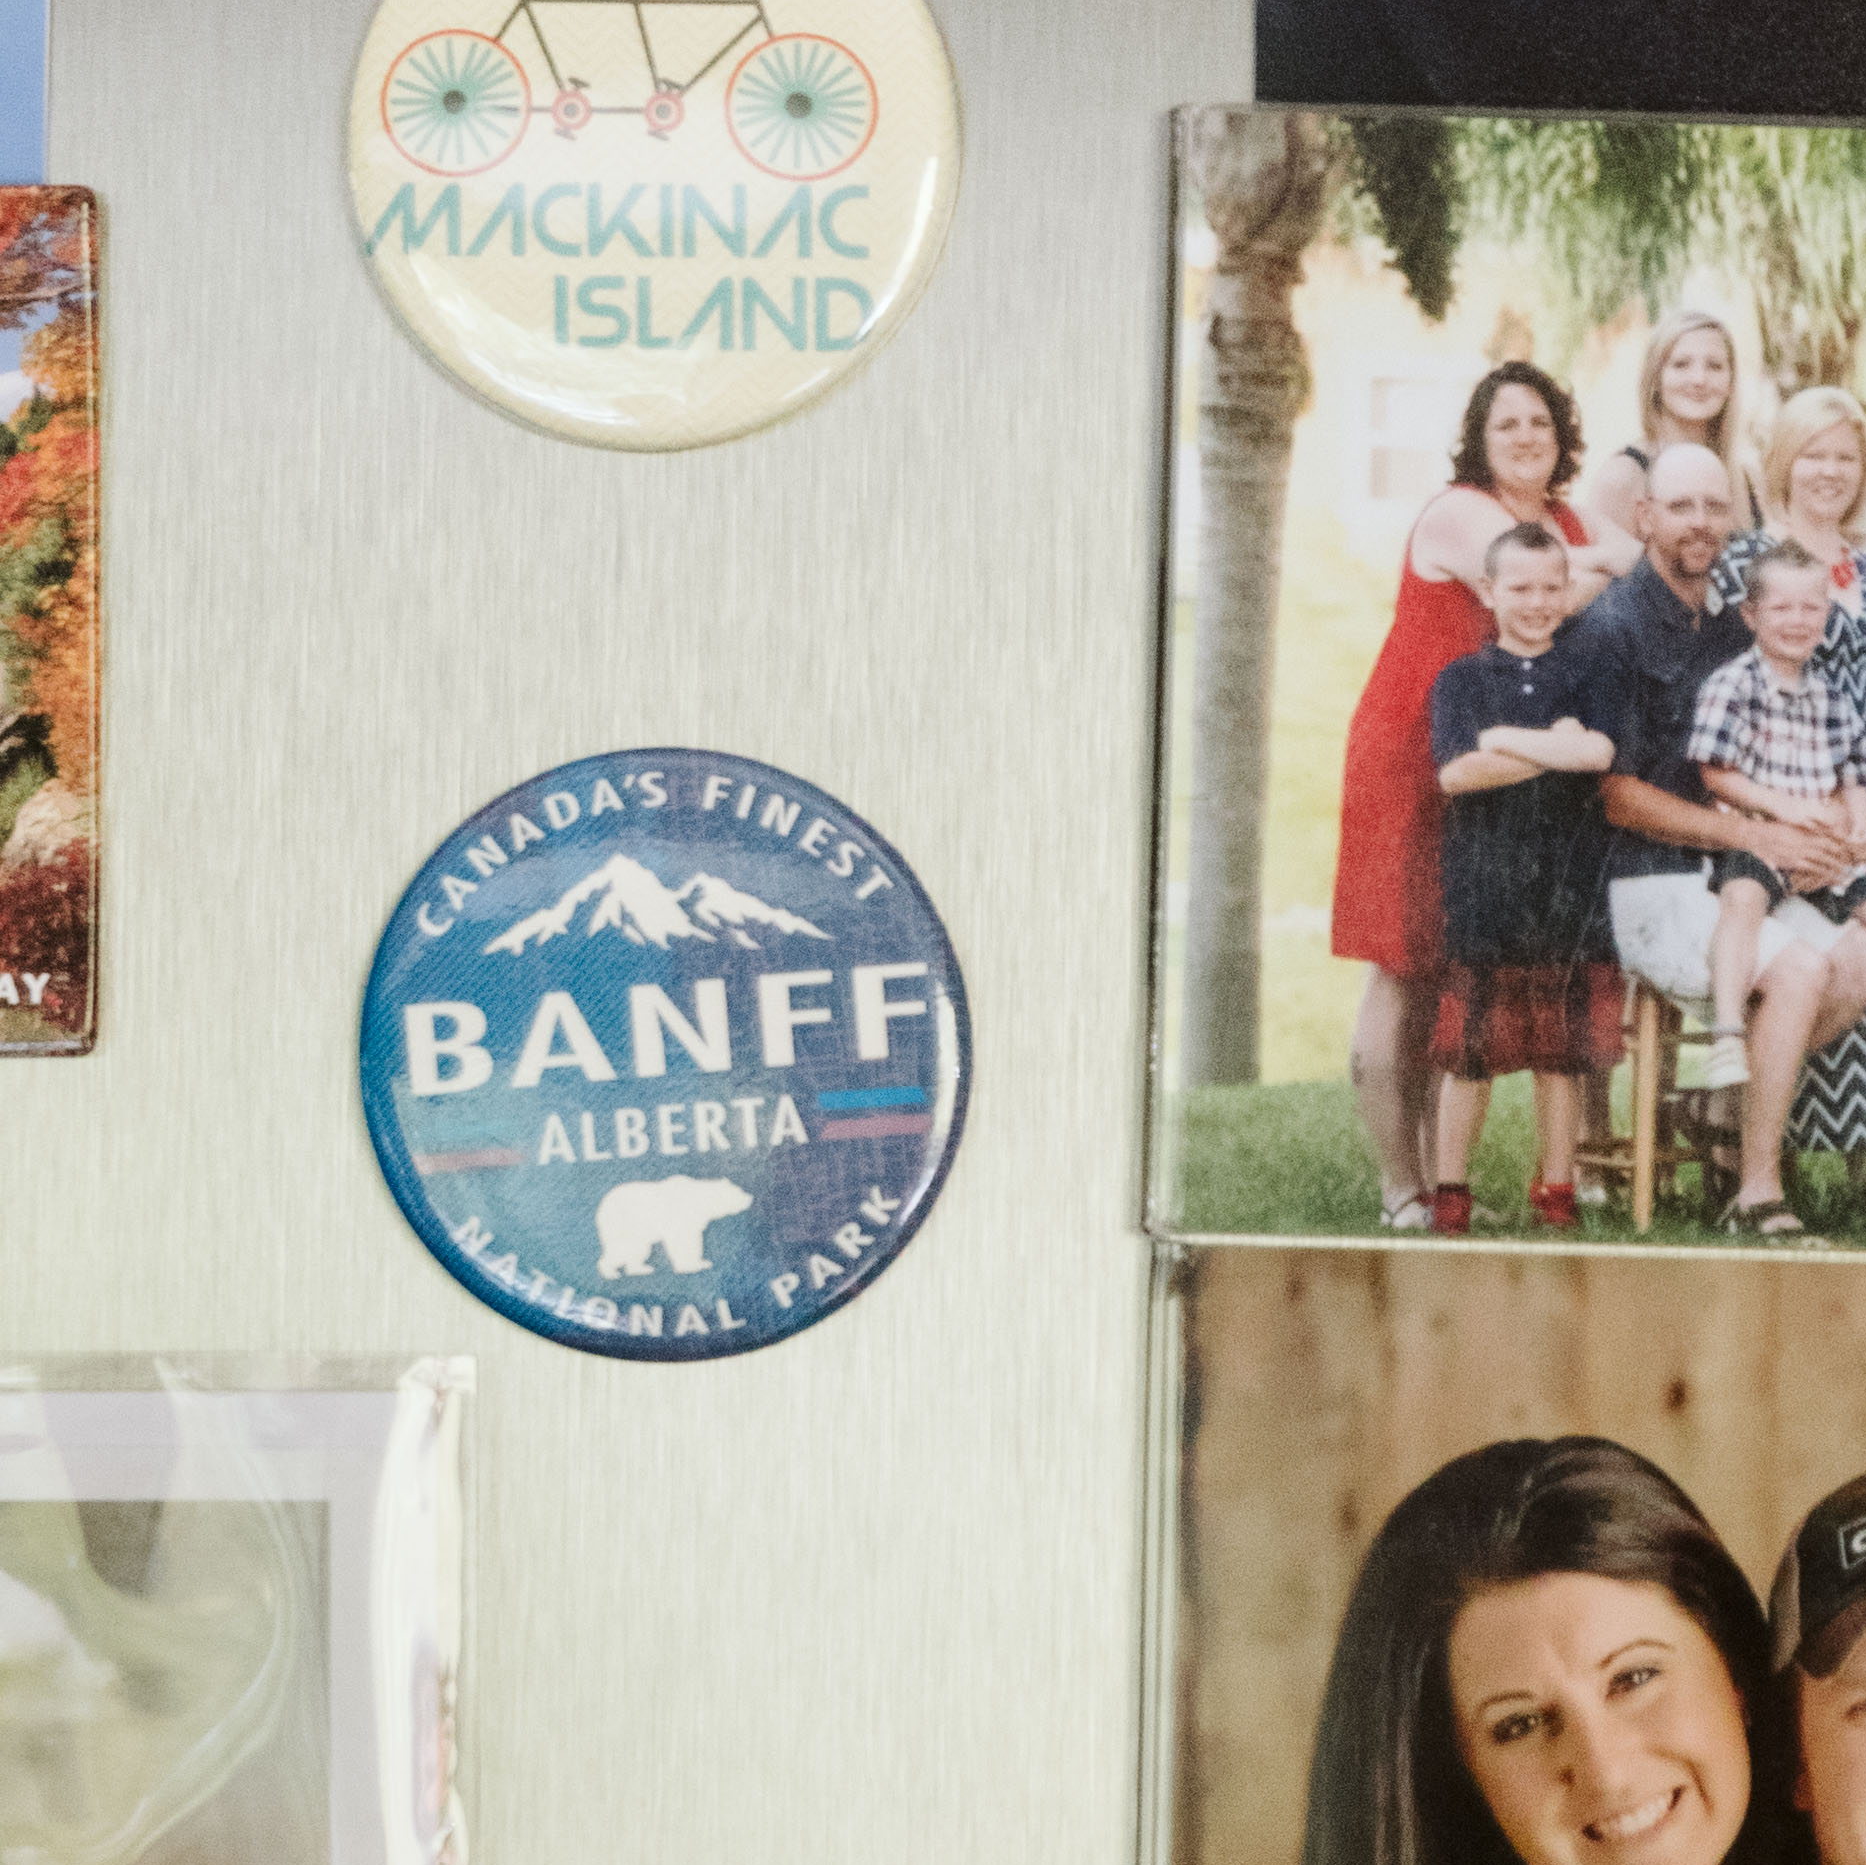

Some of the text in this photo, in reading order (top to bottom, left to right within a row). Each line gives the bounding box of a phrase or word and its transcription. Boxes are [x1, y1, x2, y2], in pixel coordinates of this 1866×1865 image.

[366, 182, 870, 258] MACKINAC
[554, 276, 875, 352] ISLAND
[415, 771, 894, 937] CANADA'S FINEST
[403, 962, 928, 1096] BANFF
[536, 1093, 809, 1166] ALBERTA
[452, 1187, 899, 1337] NATIONAL PARK
